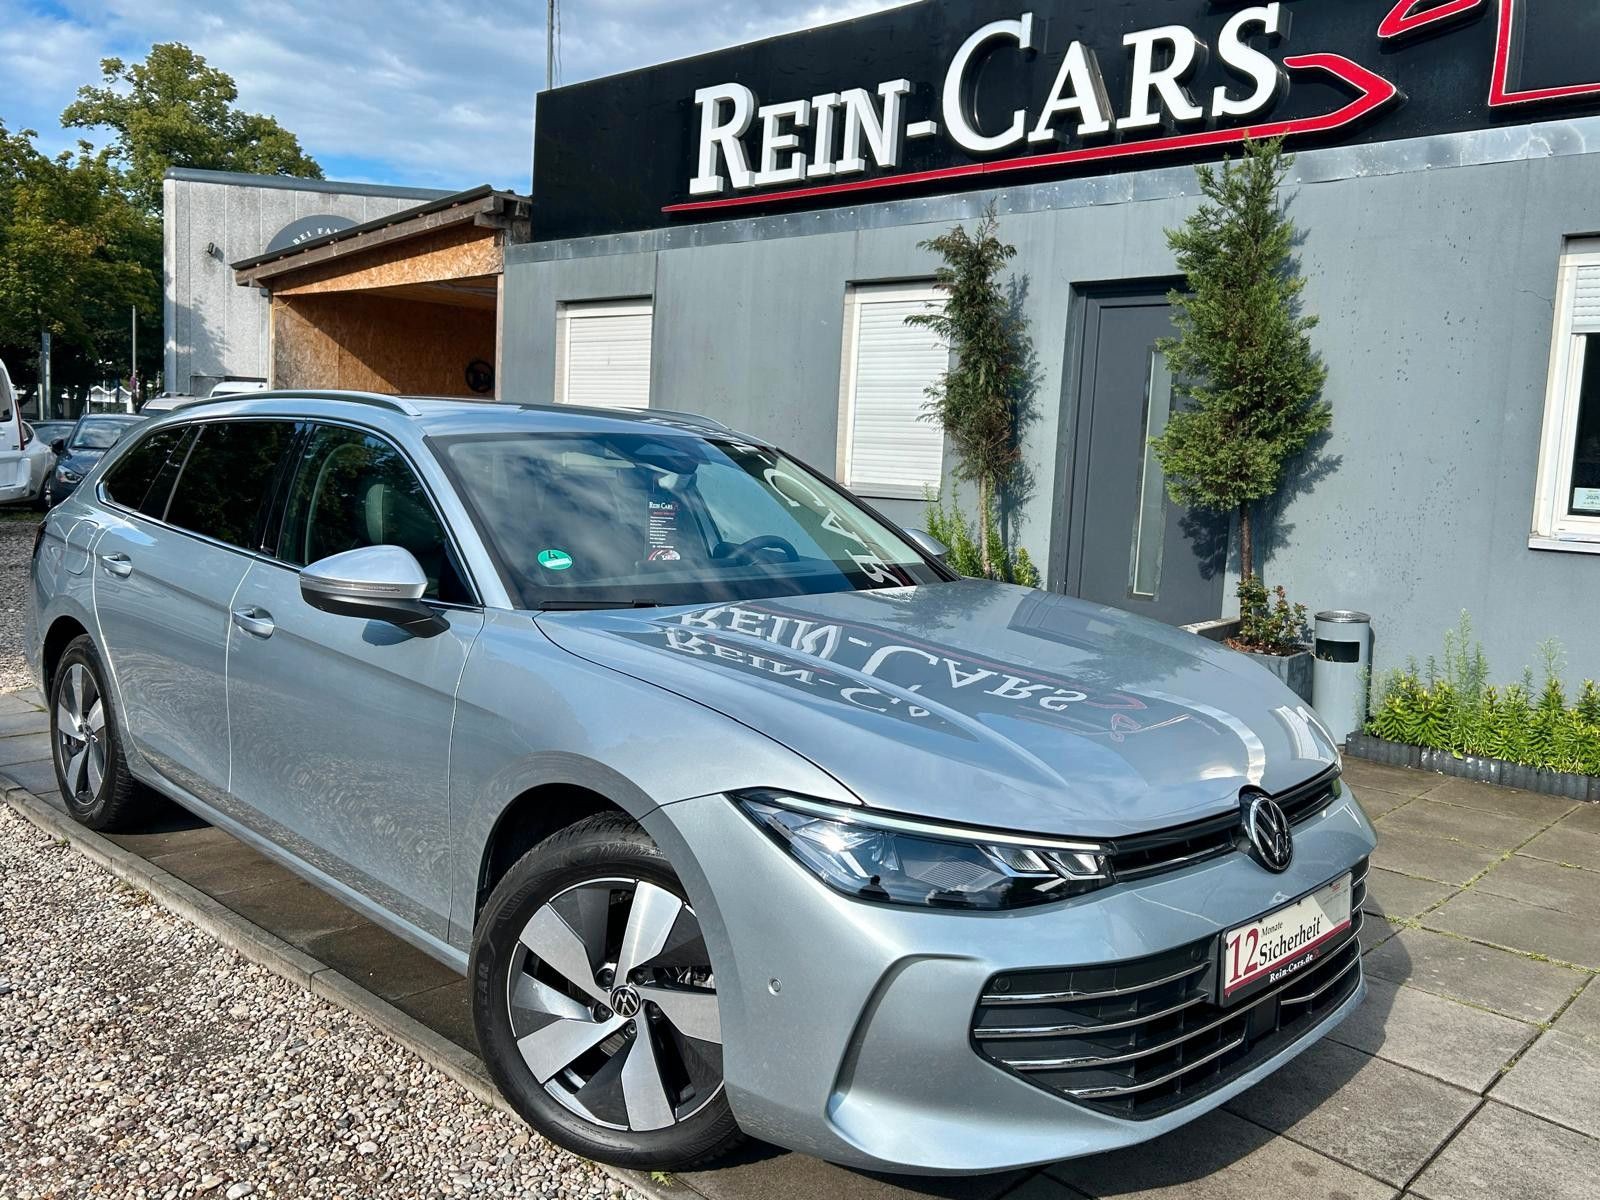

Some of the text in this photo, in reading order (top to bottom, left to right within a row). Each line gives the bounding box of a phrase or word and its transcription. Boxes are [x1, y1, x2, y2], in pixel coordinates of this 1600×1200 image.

[689, 2, 1284, 195] REIN-CARS
[1261, 921, 1284, 938] Monate
[1229, 927, 1259, 983] 12
[1269, 953, 1314, 984] Rein-Cars.de
